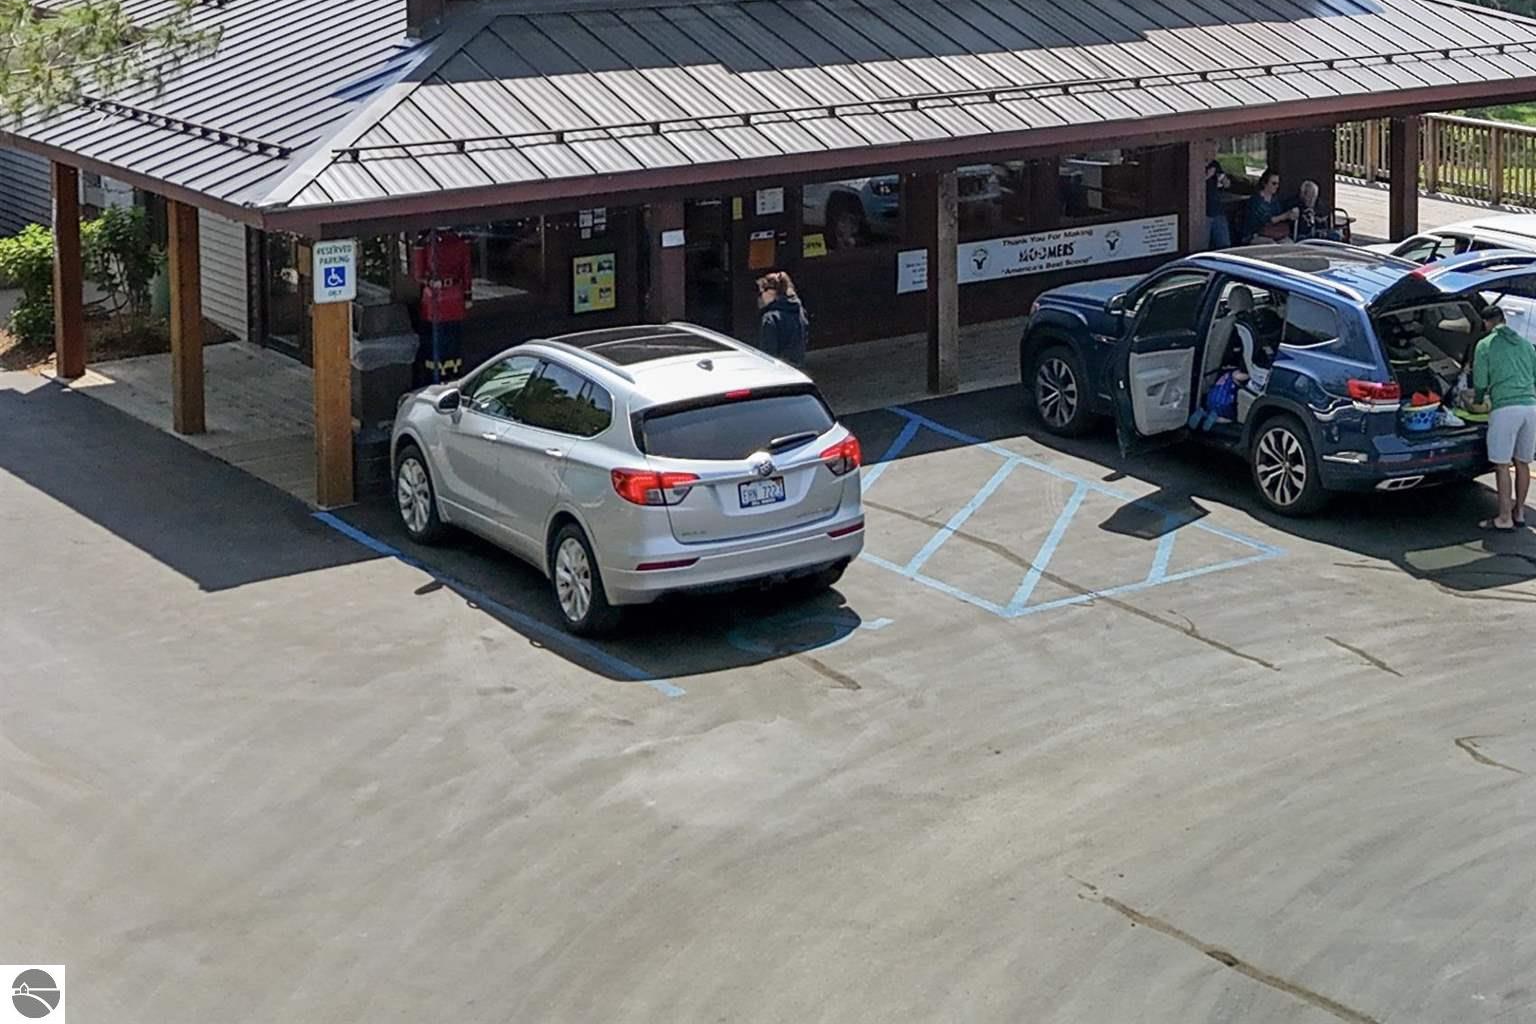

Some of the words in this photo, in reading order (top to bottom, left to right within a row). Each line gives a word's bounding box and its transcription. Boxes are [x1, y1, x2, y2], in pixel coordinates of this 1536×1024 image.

[1002, 239, 1028, 247] Thank
[1047, 233, 1061, 241] For
[317, 245, 352, 255] RESERVED
[1019, 242, 1074, 263] MOOMERS
[319, 255, 350, 265] PARKING
